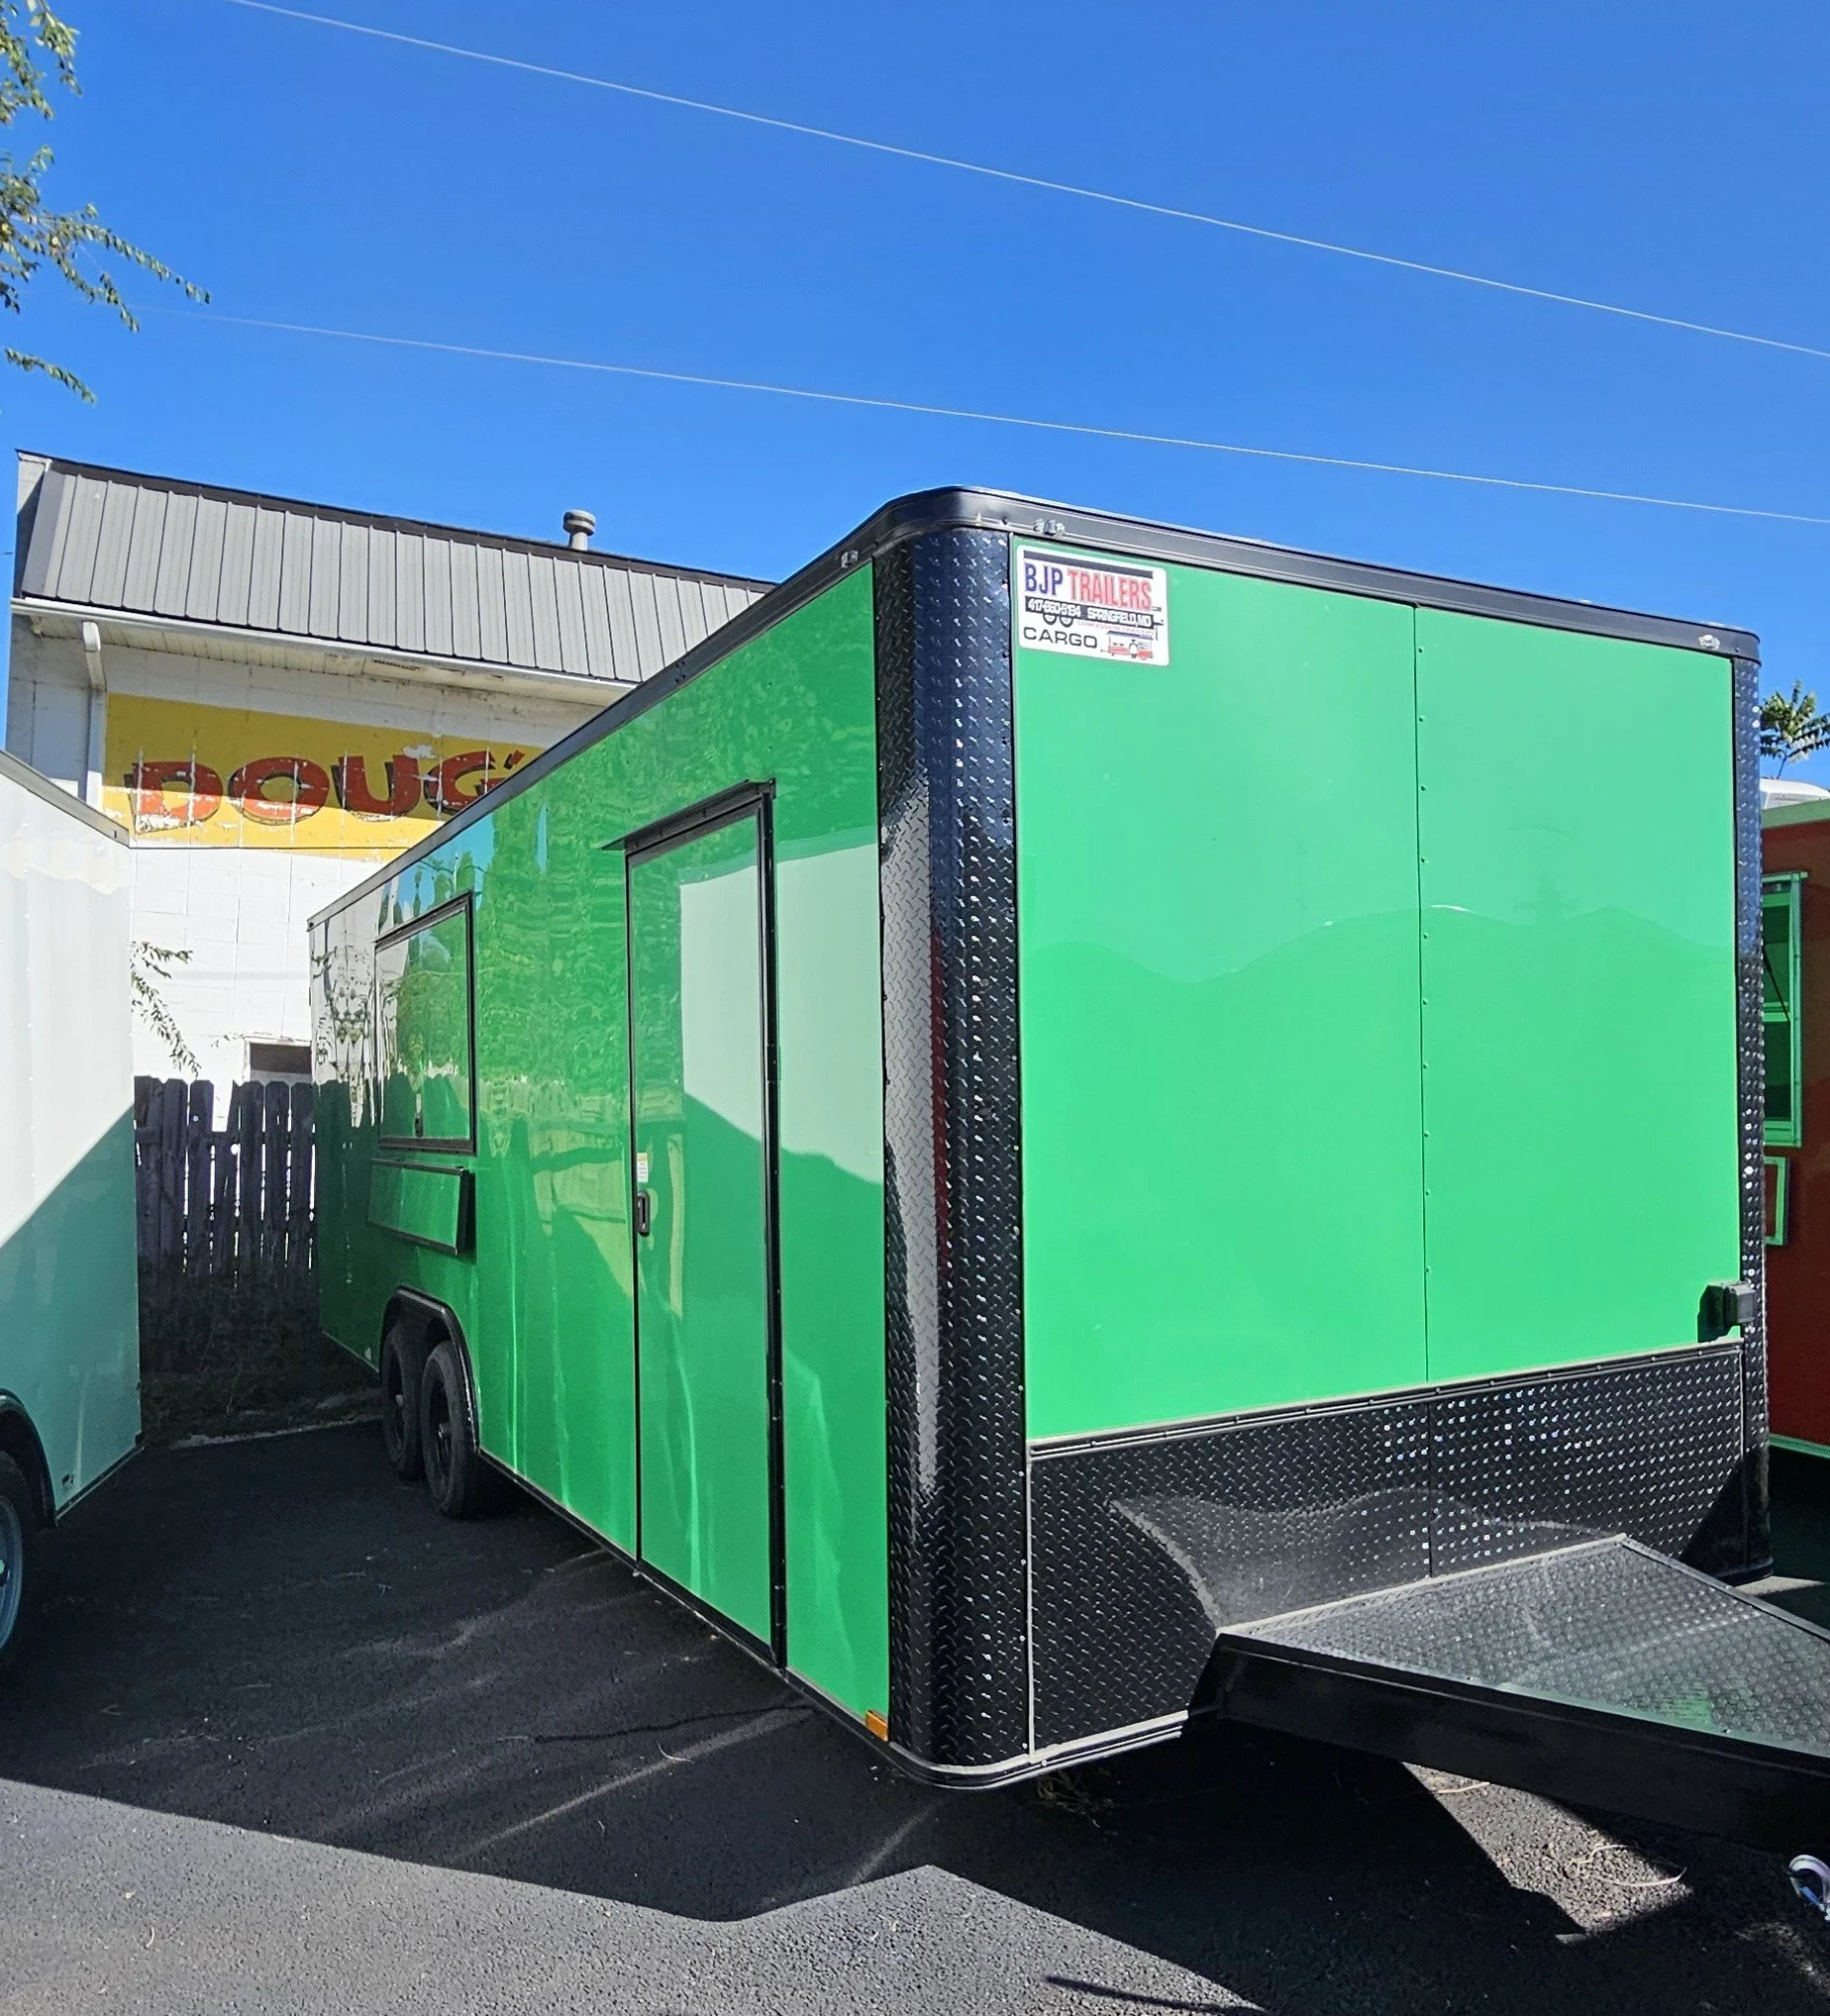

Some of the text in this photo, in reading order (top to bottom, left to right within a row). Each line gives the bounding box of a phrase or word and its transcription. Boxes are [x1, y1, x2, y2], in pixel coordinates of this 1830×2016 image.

[1024, 562, 1152, 611] BJP TRAILERS
[1024, 627, 1097, 649] CARGO
